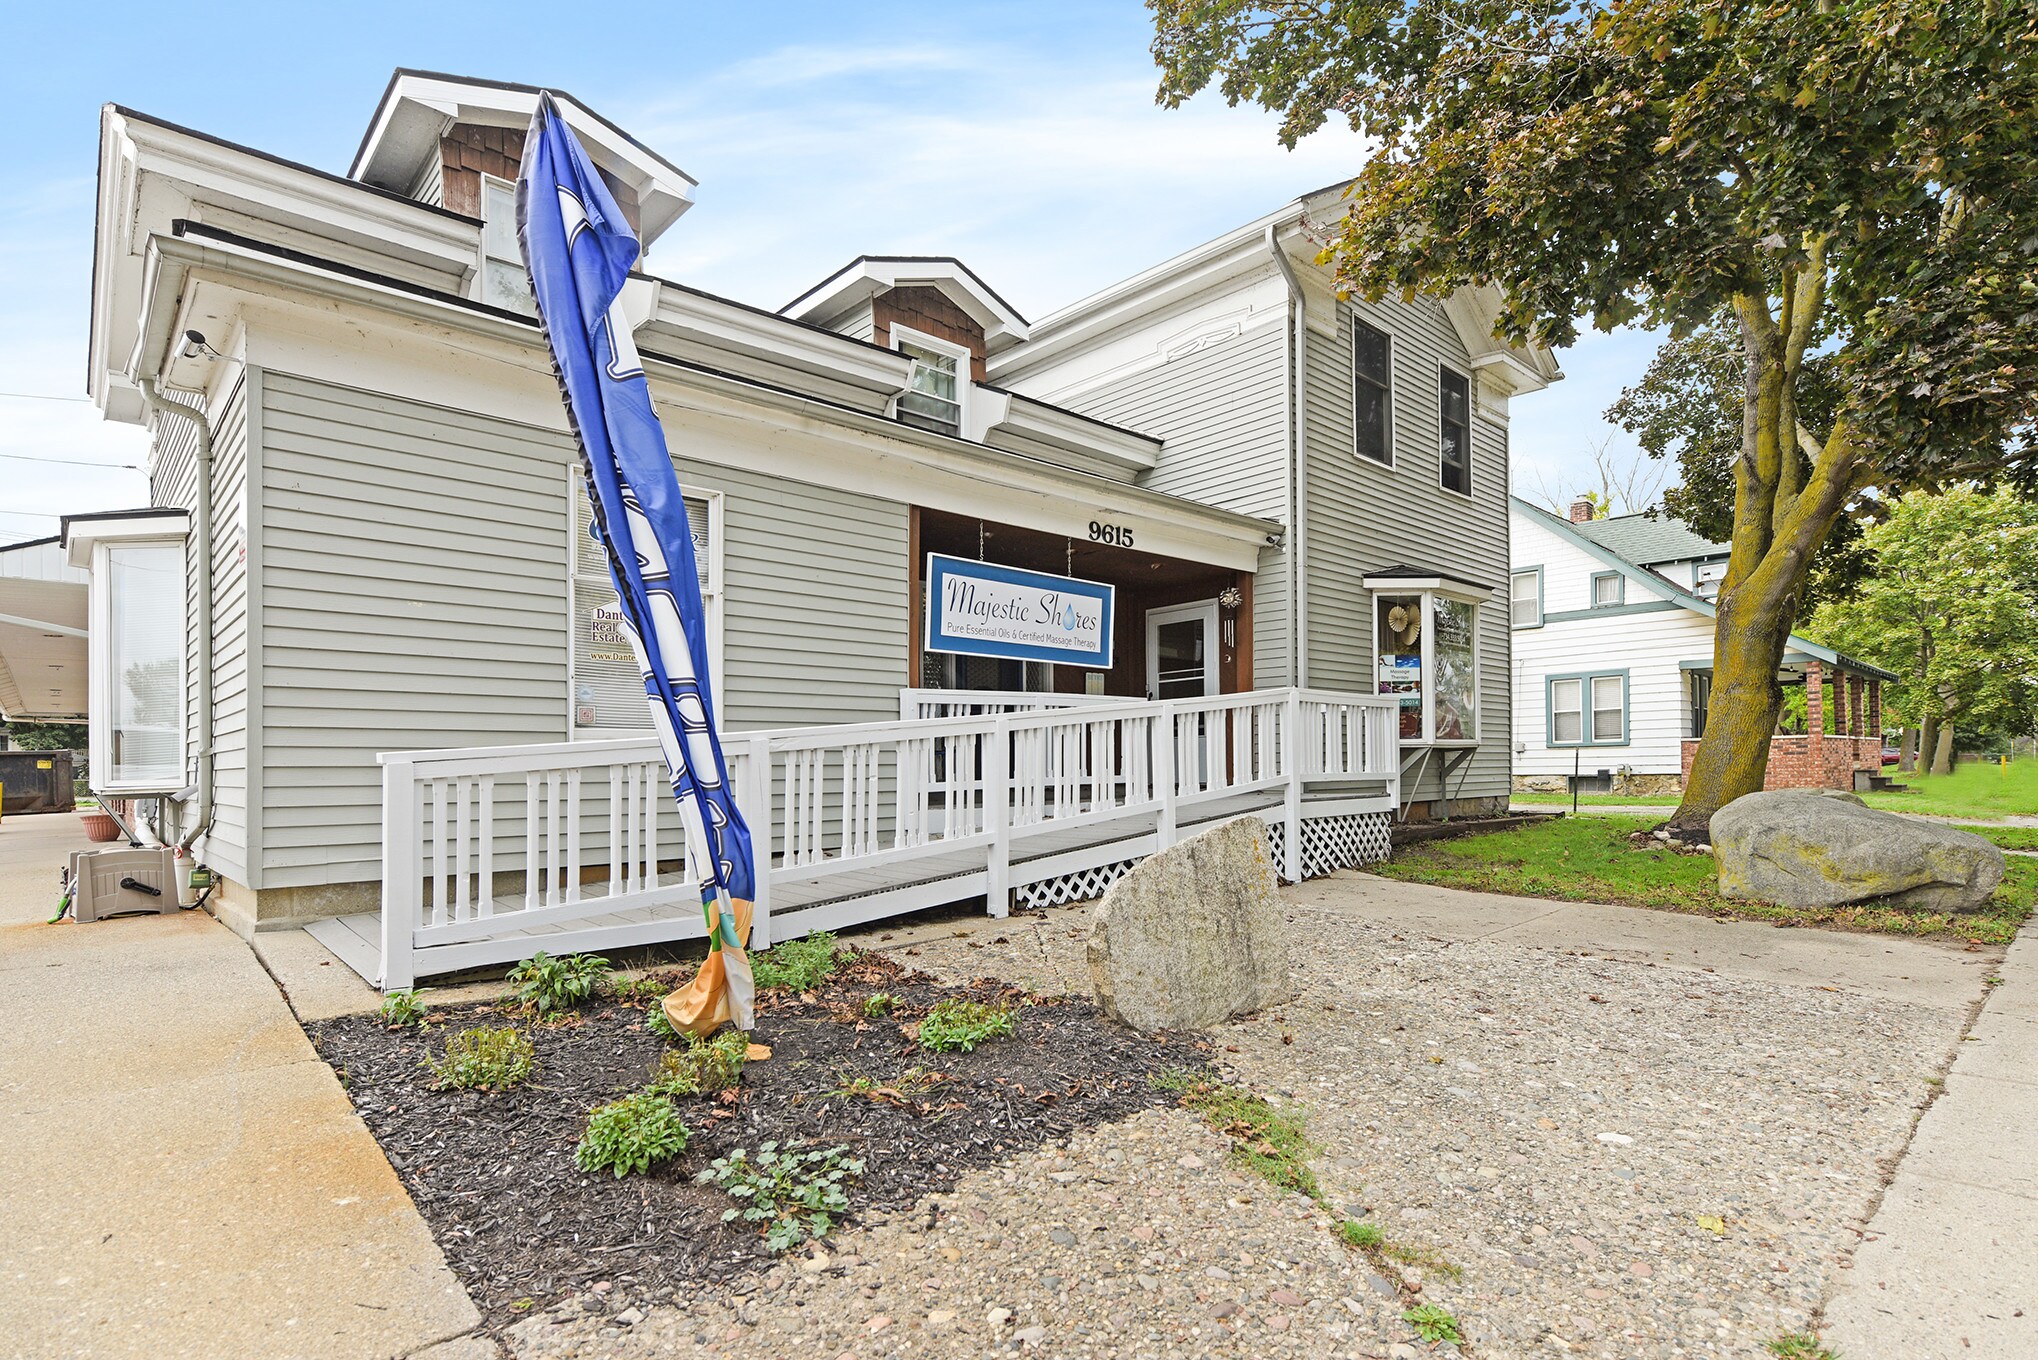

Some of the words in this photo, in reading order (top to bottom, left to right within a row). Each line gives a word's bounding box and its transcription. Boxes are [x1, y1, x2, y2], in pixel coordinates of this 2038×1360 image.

[1088, 520, 1134, 548] 9615
[947, 577, 1030, 626] Majestic
[596, 608, 624, 621] Dant
[592, 621, 616, 632] Real
[946, 621, 965, 634] Pure
[966, 623, 997, 637] Essential
[998, 627, 1010, 639] Oils
[1011, 629, 1017, 640] &
[1018, 630, 1045, 643] Certified
[1046, 633, 1073, 648] Massage
[1074, 636, 1097, 651] Therapy
[590, 652, 637, 662] www.Dante
